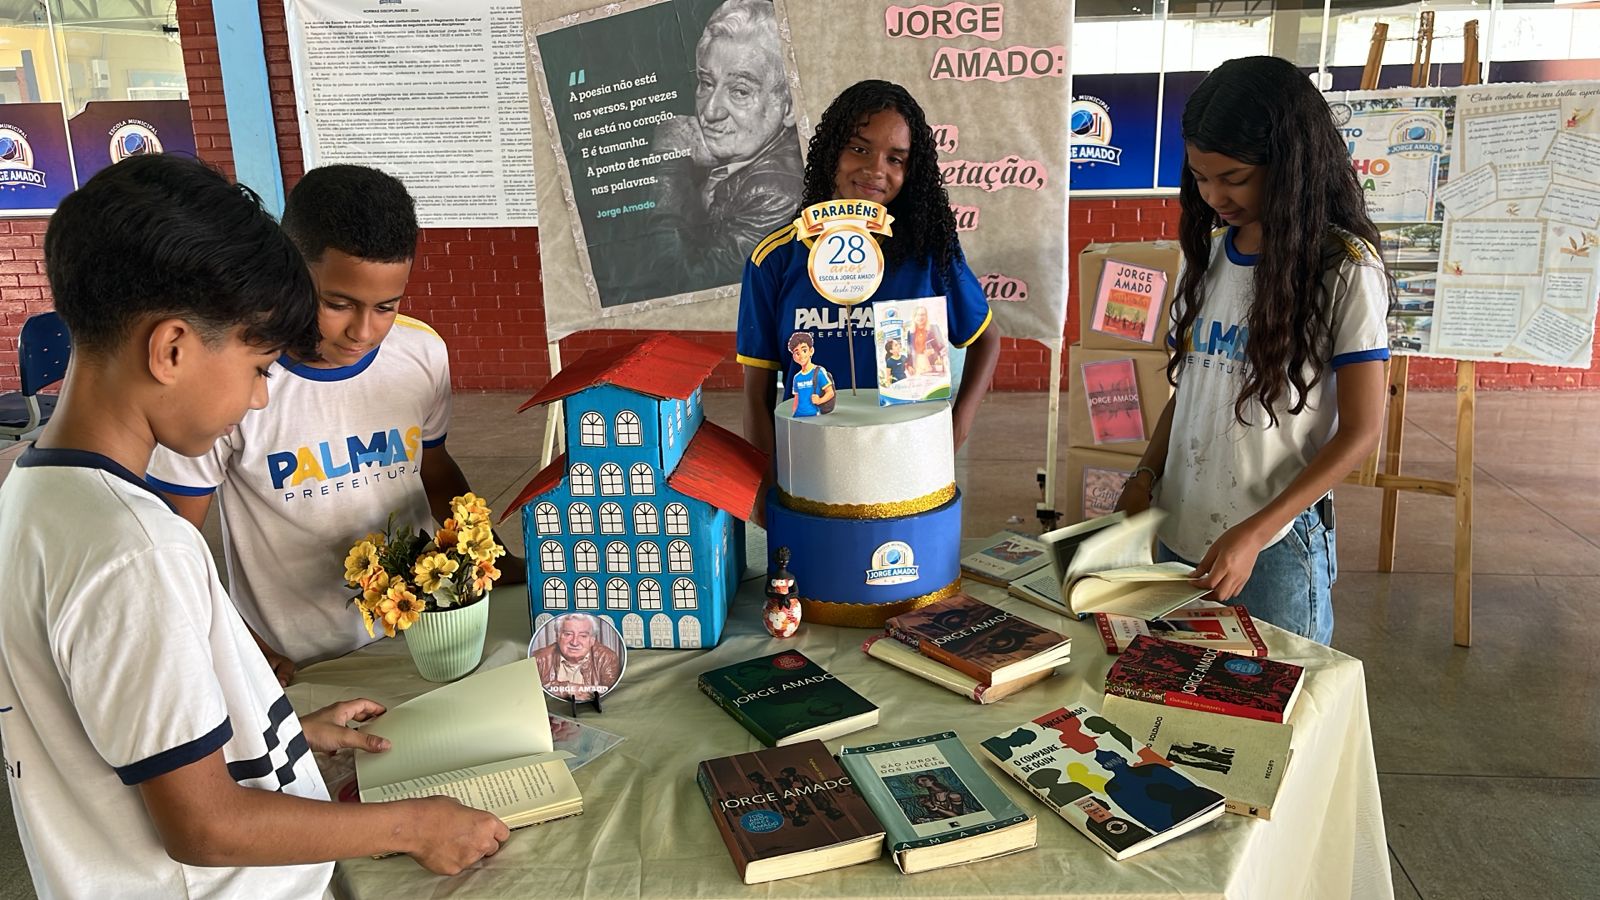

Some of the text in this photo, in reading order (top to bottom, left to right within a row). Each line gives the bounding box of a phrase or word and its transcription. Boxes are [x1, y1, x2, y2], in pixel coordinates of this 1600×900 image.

[888, 7, 1000, 37] JORGE
[932, 49, 1063, 79] AMADO:
[569, 72, 657, 103] A poesia não está
[573, 90, 678, 121] nos versos, por vezes
[1079, 94, 1111, 112] MUNICIPAL
[108, 118, 158, 136] ESCOLA MUNICIPAL
[577, 111, 677, 140] ela está no coração.
[581, 137, 649, 158] E é tamanha.
[1079, 147, 1116, 161] AMADO
[586, 147, 692, 178] A ponto de não caber
[10, 170, 41, 183] AMADO
[591, 175, 659, 196] nas palavras.
[596, 200, 656, 219] Jorge Amado
[812, 203, 879, 221] PARABÉNS
[827, 235, 866, 265] 28
[818, 274, 839, 282] ESCOLA
[830, 264, 865, 274] anos
[1117, 267, 1154, 283] JORGE
[832, 285, 848, 293] desde
[1114, 278, 1152, 293] AMADO
[1090, 396, 1112, 407] JORGE
[267, 424, 421, 490] PALMAS
[285, 465, 420, 502] PREFEITURA
[870, 567, 916, 579] JORGE AMADO
[930, 610, 1017, 648] JORGE AMADO
[1182, 648, 1219, 696] JORGE AMADO
[548, 685, 609, 694] JORGE AMADO
[732, 686, 780, 708] JORGE
[782, 671, 836, 692] AMADO
[1039, 706, 1088, 731] JORGE AMADO
[1149, 716, 1163, 742] SOLDADO
[880, 756, 939, 769] SÃO JORGE
[1014, 743, 1062, 767] O COMPADRE
[1021, 755, 1058, 774] DE OGUM
[905, 760, 946, 772] ILHÉUS
[720, 777, 852, 813] JORGE AMADO
